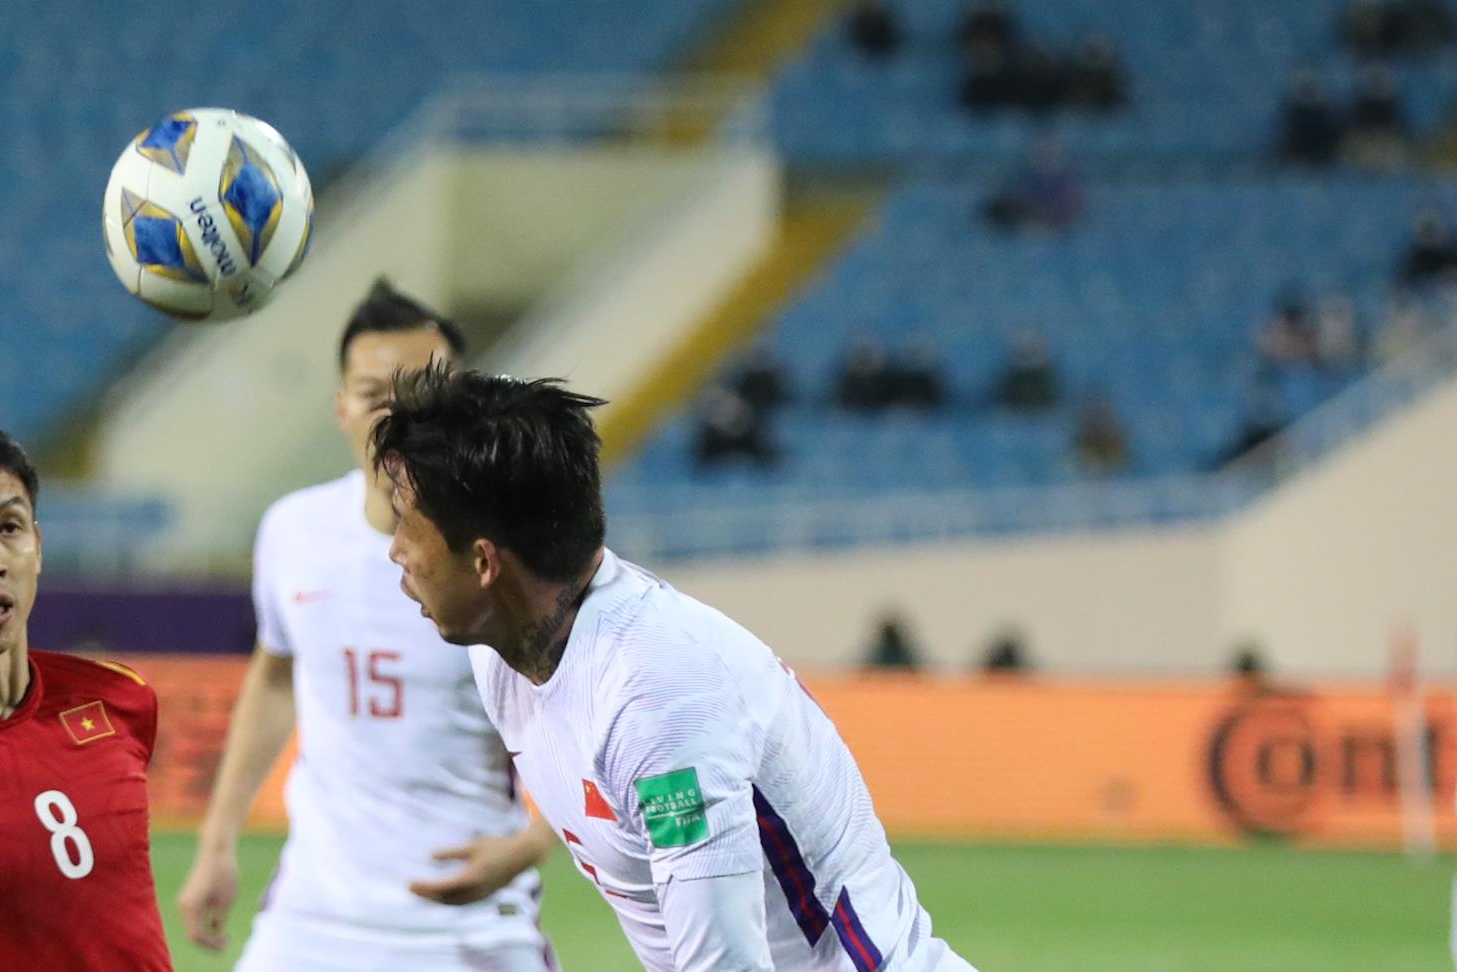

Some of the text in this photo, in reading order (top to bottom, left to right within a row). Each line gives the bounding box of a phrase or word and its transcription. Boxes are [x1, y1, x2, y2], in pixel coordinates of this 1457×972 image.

[189, 196, 237, 277] molten
[343, 648, 405, 718] 15
[34, 790, 94, 880] 8
[645, 798, 697, 814] FOOTBALL
